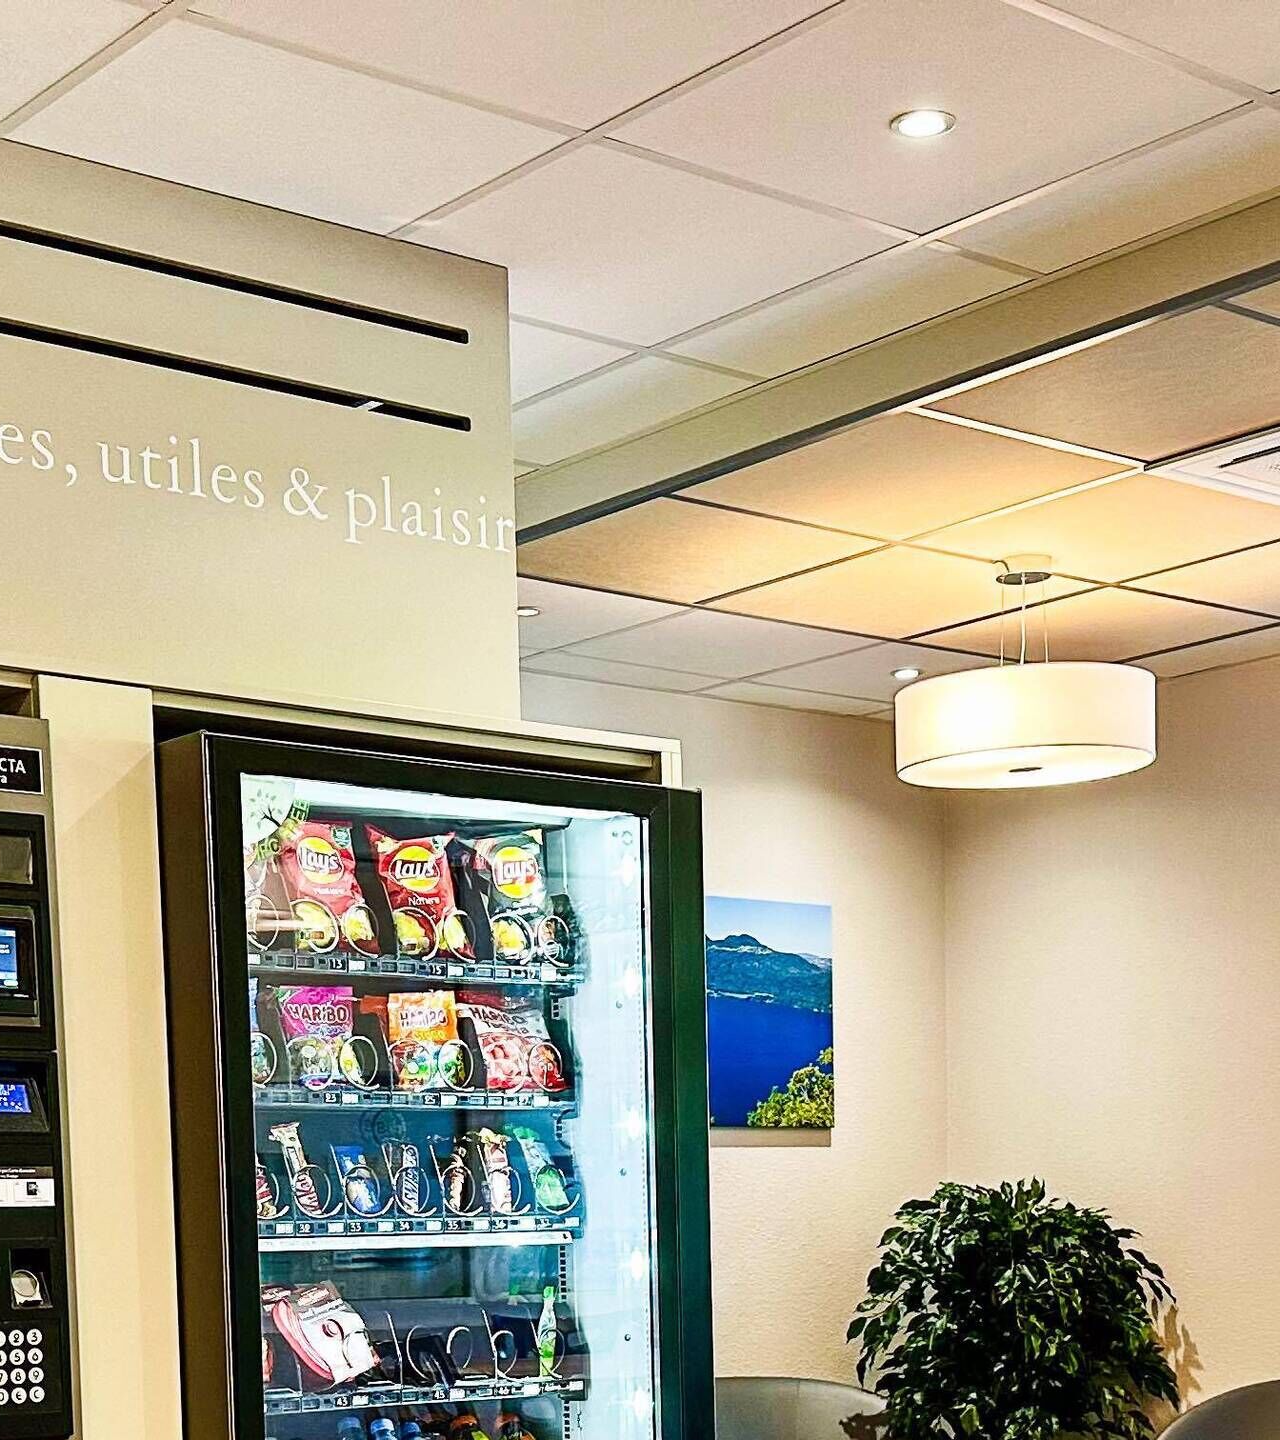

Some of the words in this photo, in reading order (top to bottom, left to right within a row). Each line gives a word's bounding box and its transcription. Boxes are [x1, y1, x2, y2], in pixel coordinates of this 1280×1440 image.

[96, 435, 265, 510] utiles
[282, 466, 329, 521] &
[287, 1003, 349, 1024] HARIBO
[13, 1332, 20, 1343] 2
[31, 1332, 38, 1343] 3
[14, 1352, 20, 1362] 5
[32, 1352, 39, 1361] 6
[15, 1372, 22, 1382] 8
[33, 1370, 40, 1380] 9
